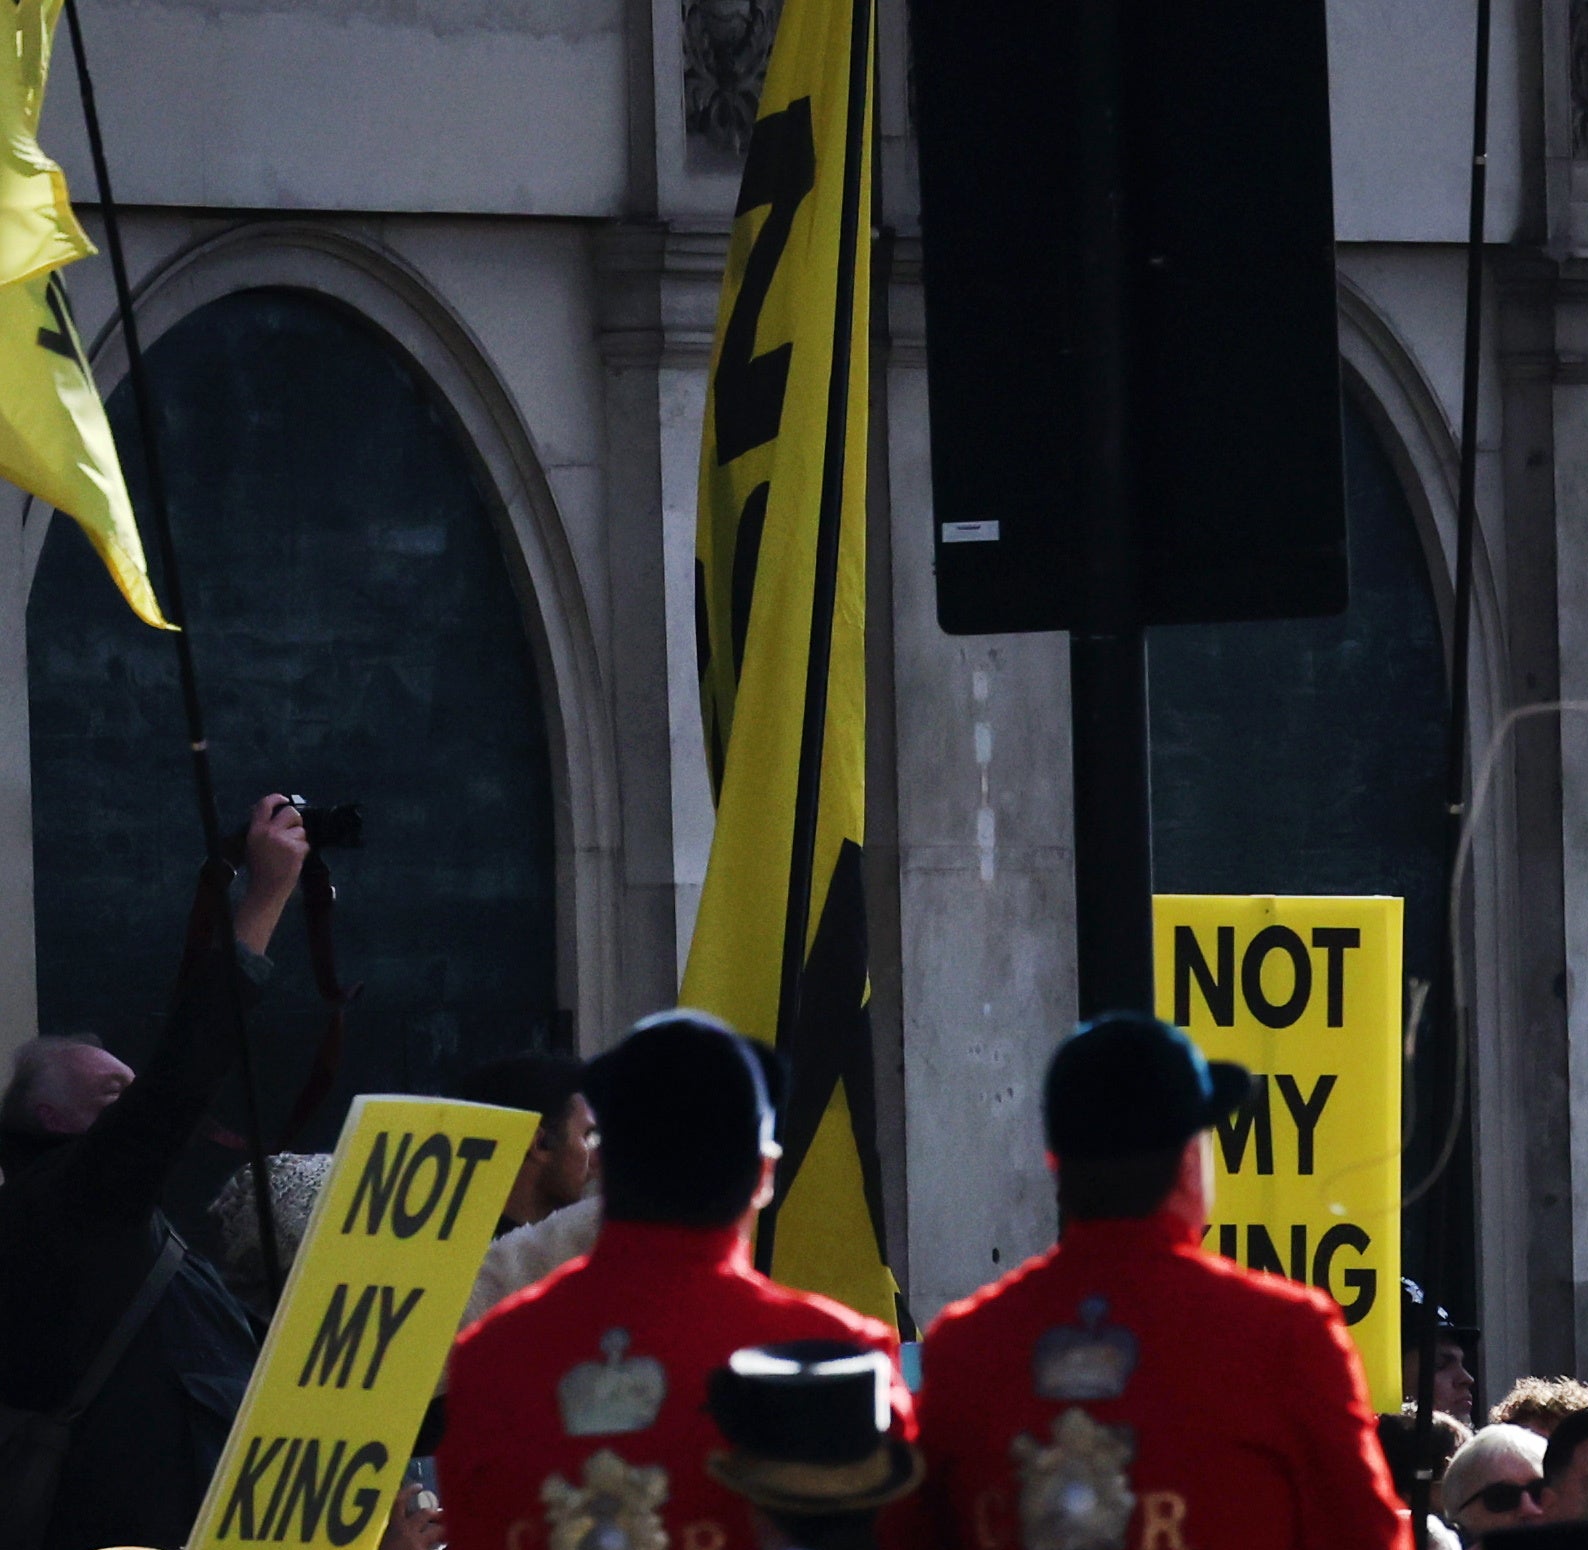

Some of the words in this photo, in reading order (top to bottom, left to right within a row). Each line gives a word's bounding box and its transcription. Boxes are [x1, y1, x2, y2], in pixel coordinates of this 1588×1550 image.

[1173, 925, 1360, 1029] NOT
[341, 1132, 498, 1241] NOT
[297, 1284, 425, 1389] MY
[216, 1436, 390, 1547] KING
